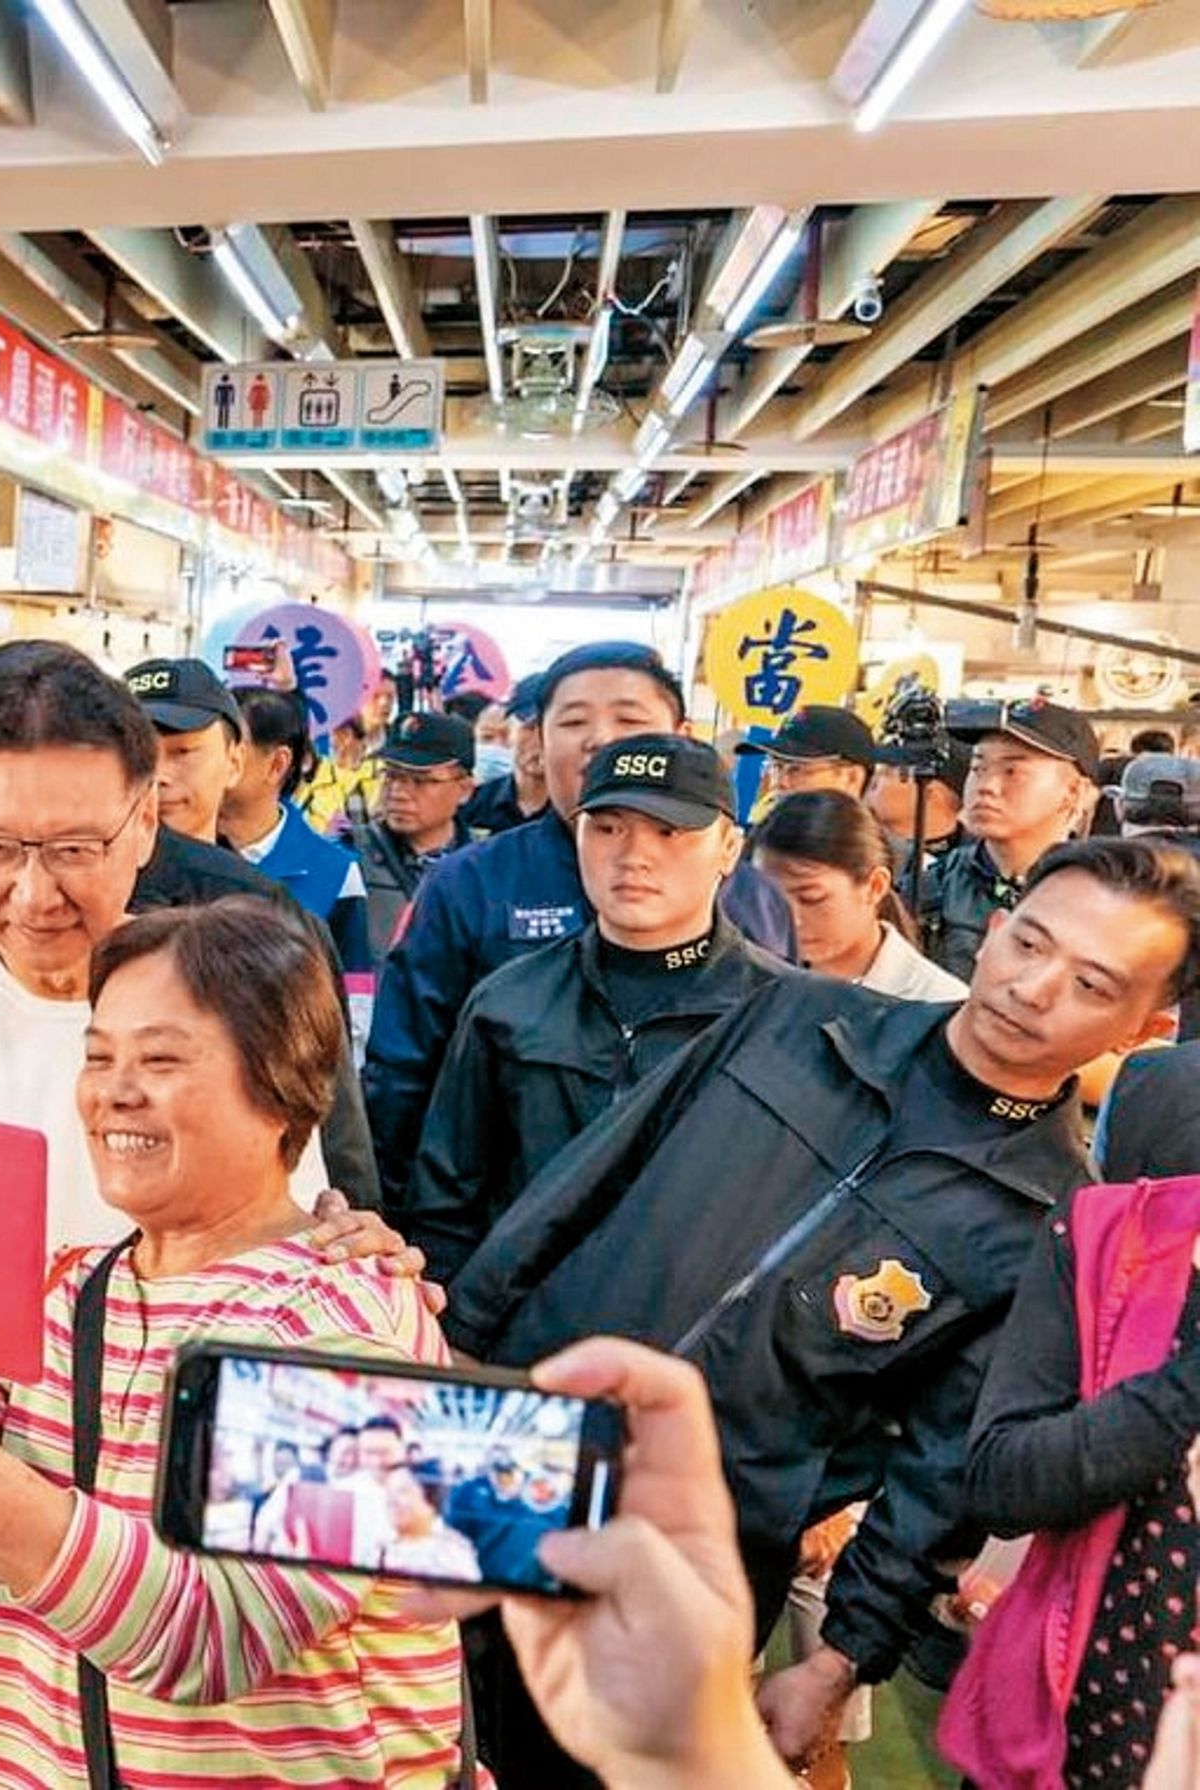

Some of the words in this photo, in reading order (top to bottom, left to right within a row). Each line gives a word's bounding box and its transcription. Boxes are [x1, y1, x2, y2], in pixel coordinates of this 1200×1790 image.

[738, 608, 829, 715] 當
[614, 754, 667, 778] SSC
[665, 939, 711, 970] SSC
